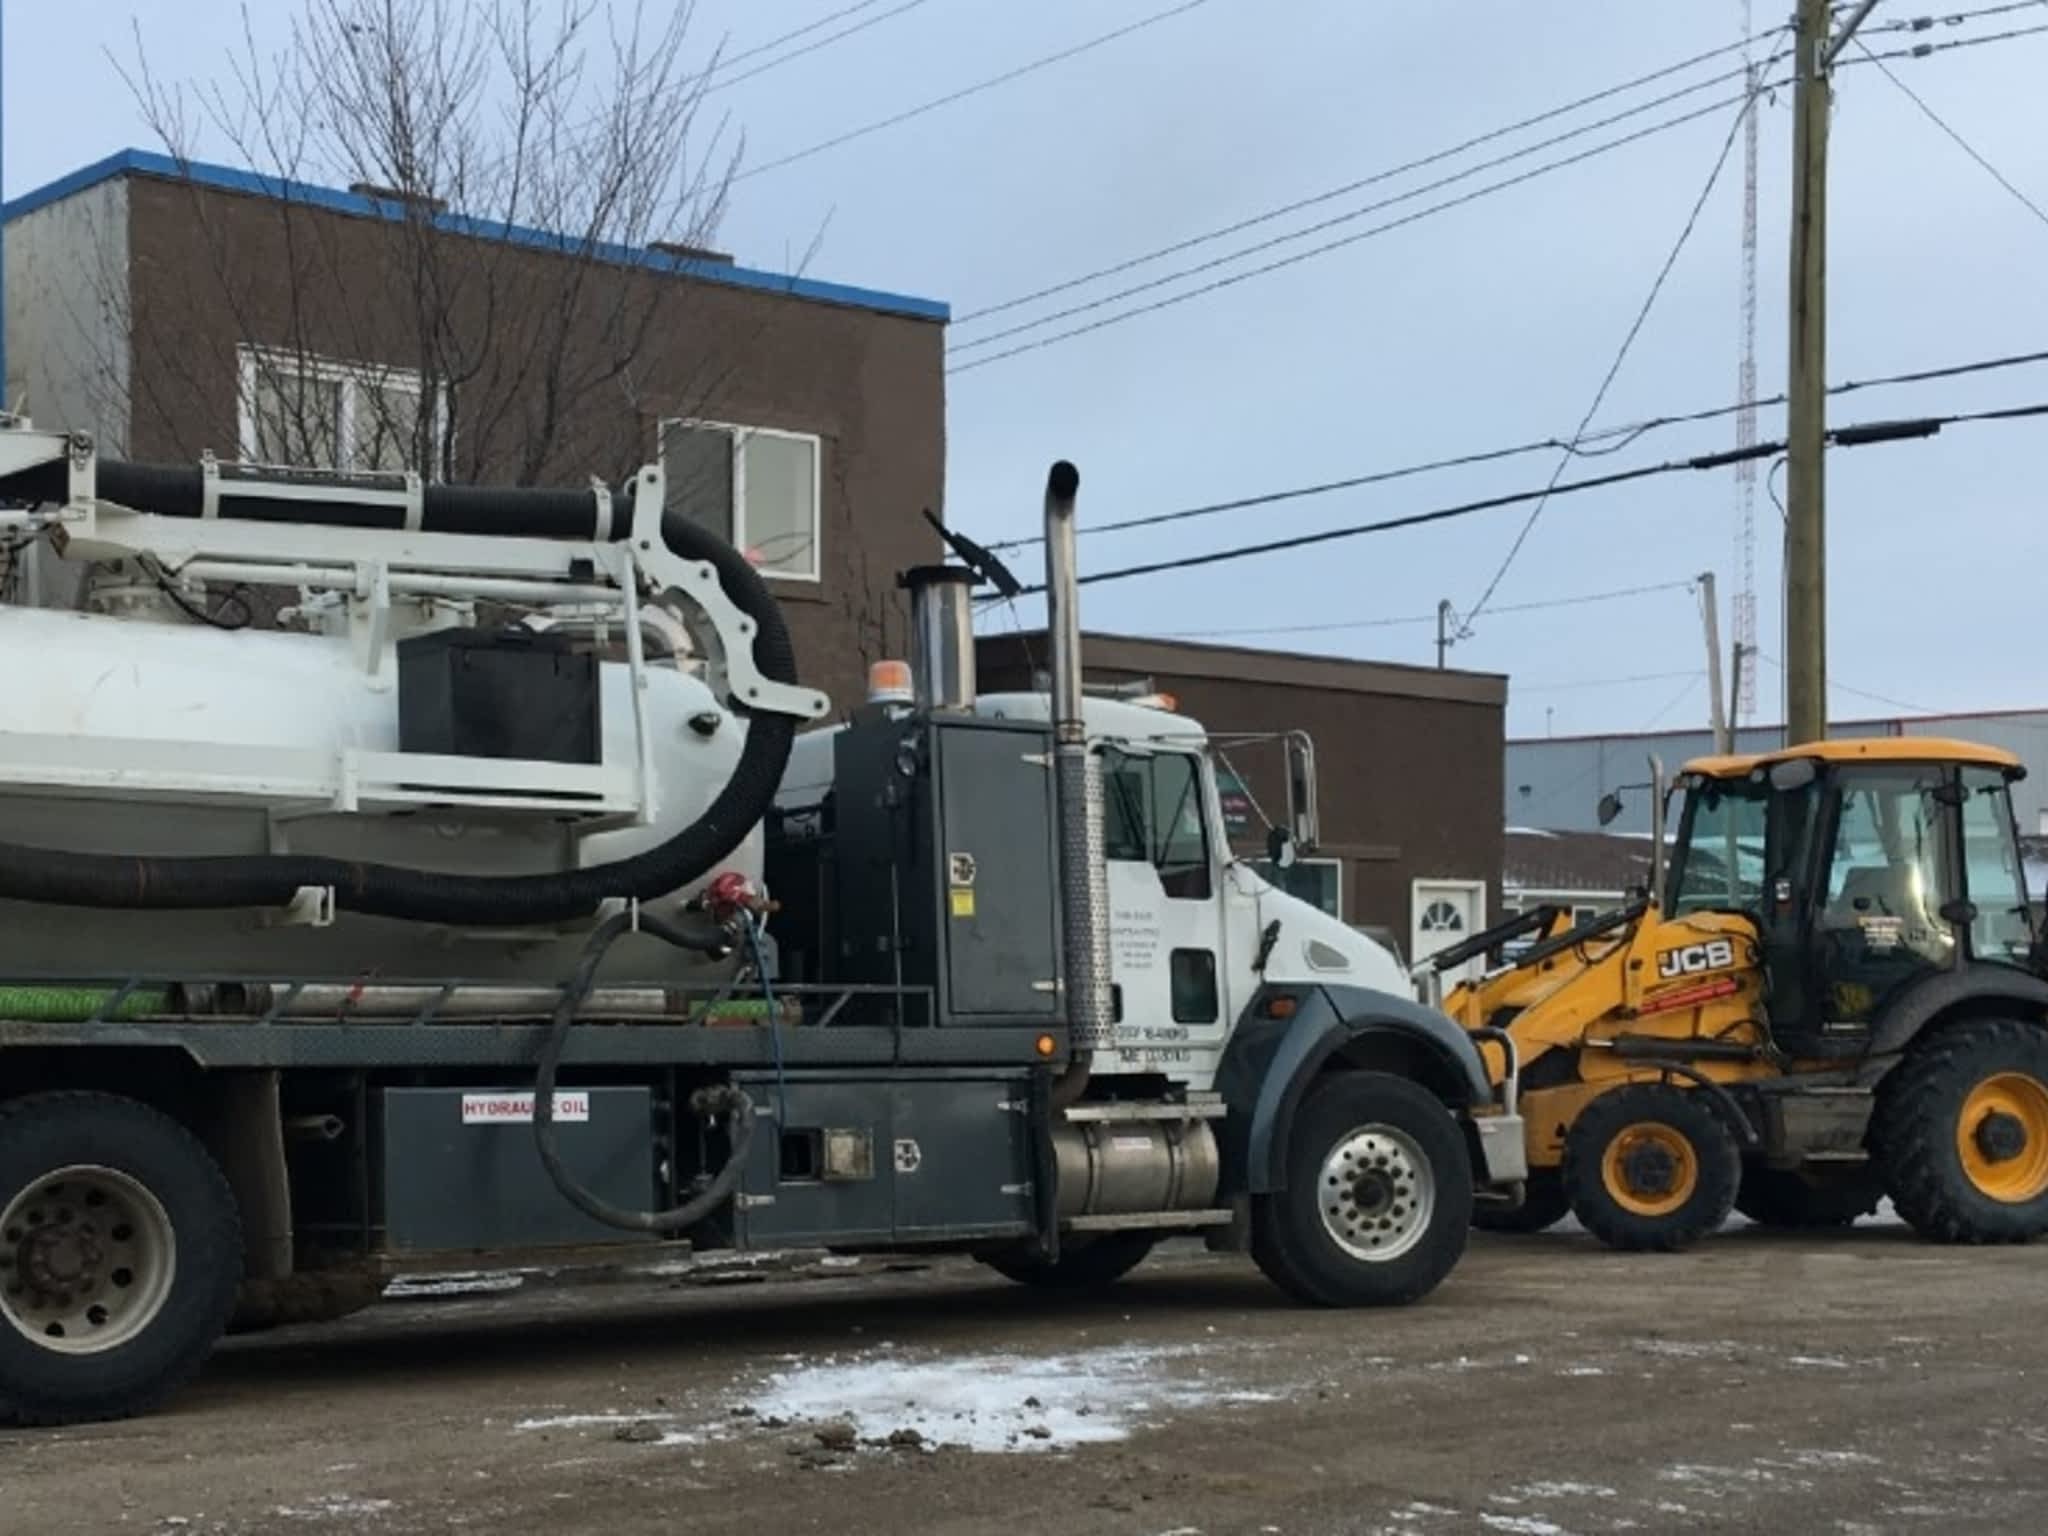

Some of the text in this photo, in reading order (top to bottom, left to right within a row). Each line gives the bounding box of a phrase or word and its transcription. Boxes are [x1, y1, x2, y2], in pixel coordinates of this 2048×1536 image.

[1659, 940, 1732, 977] JCB
[464, 1100, 588, 1116] HYDRAU OIL
